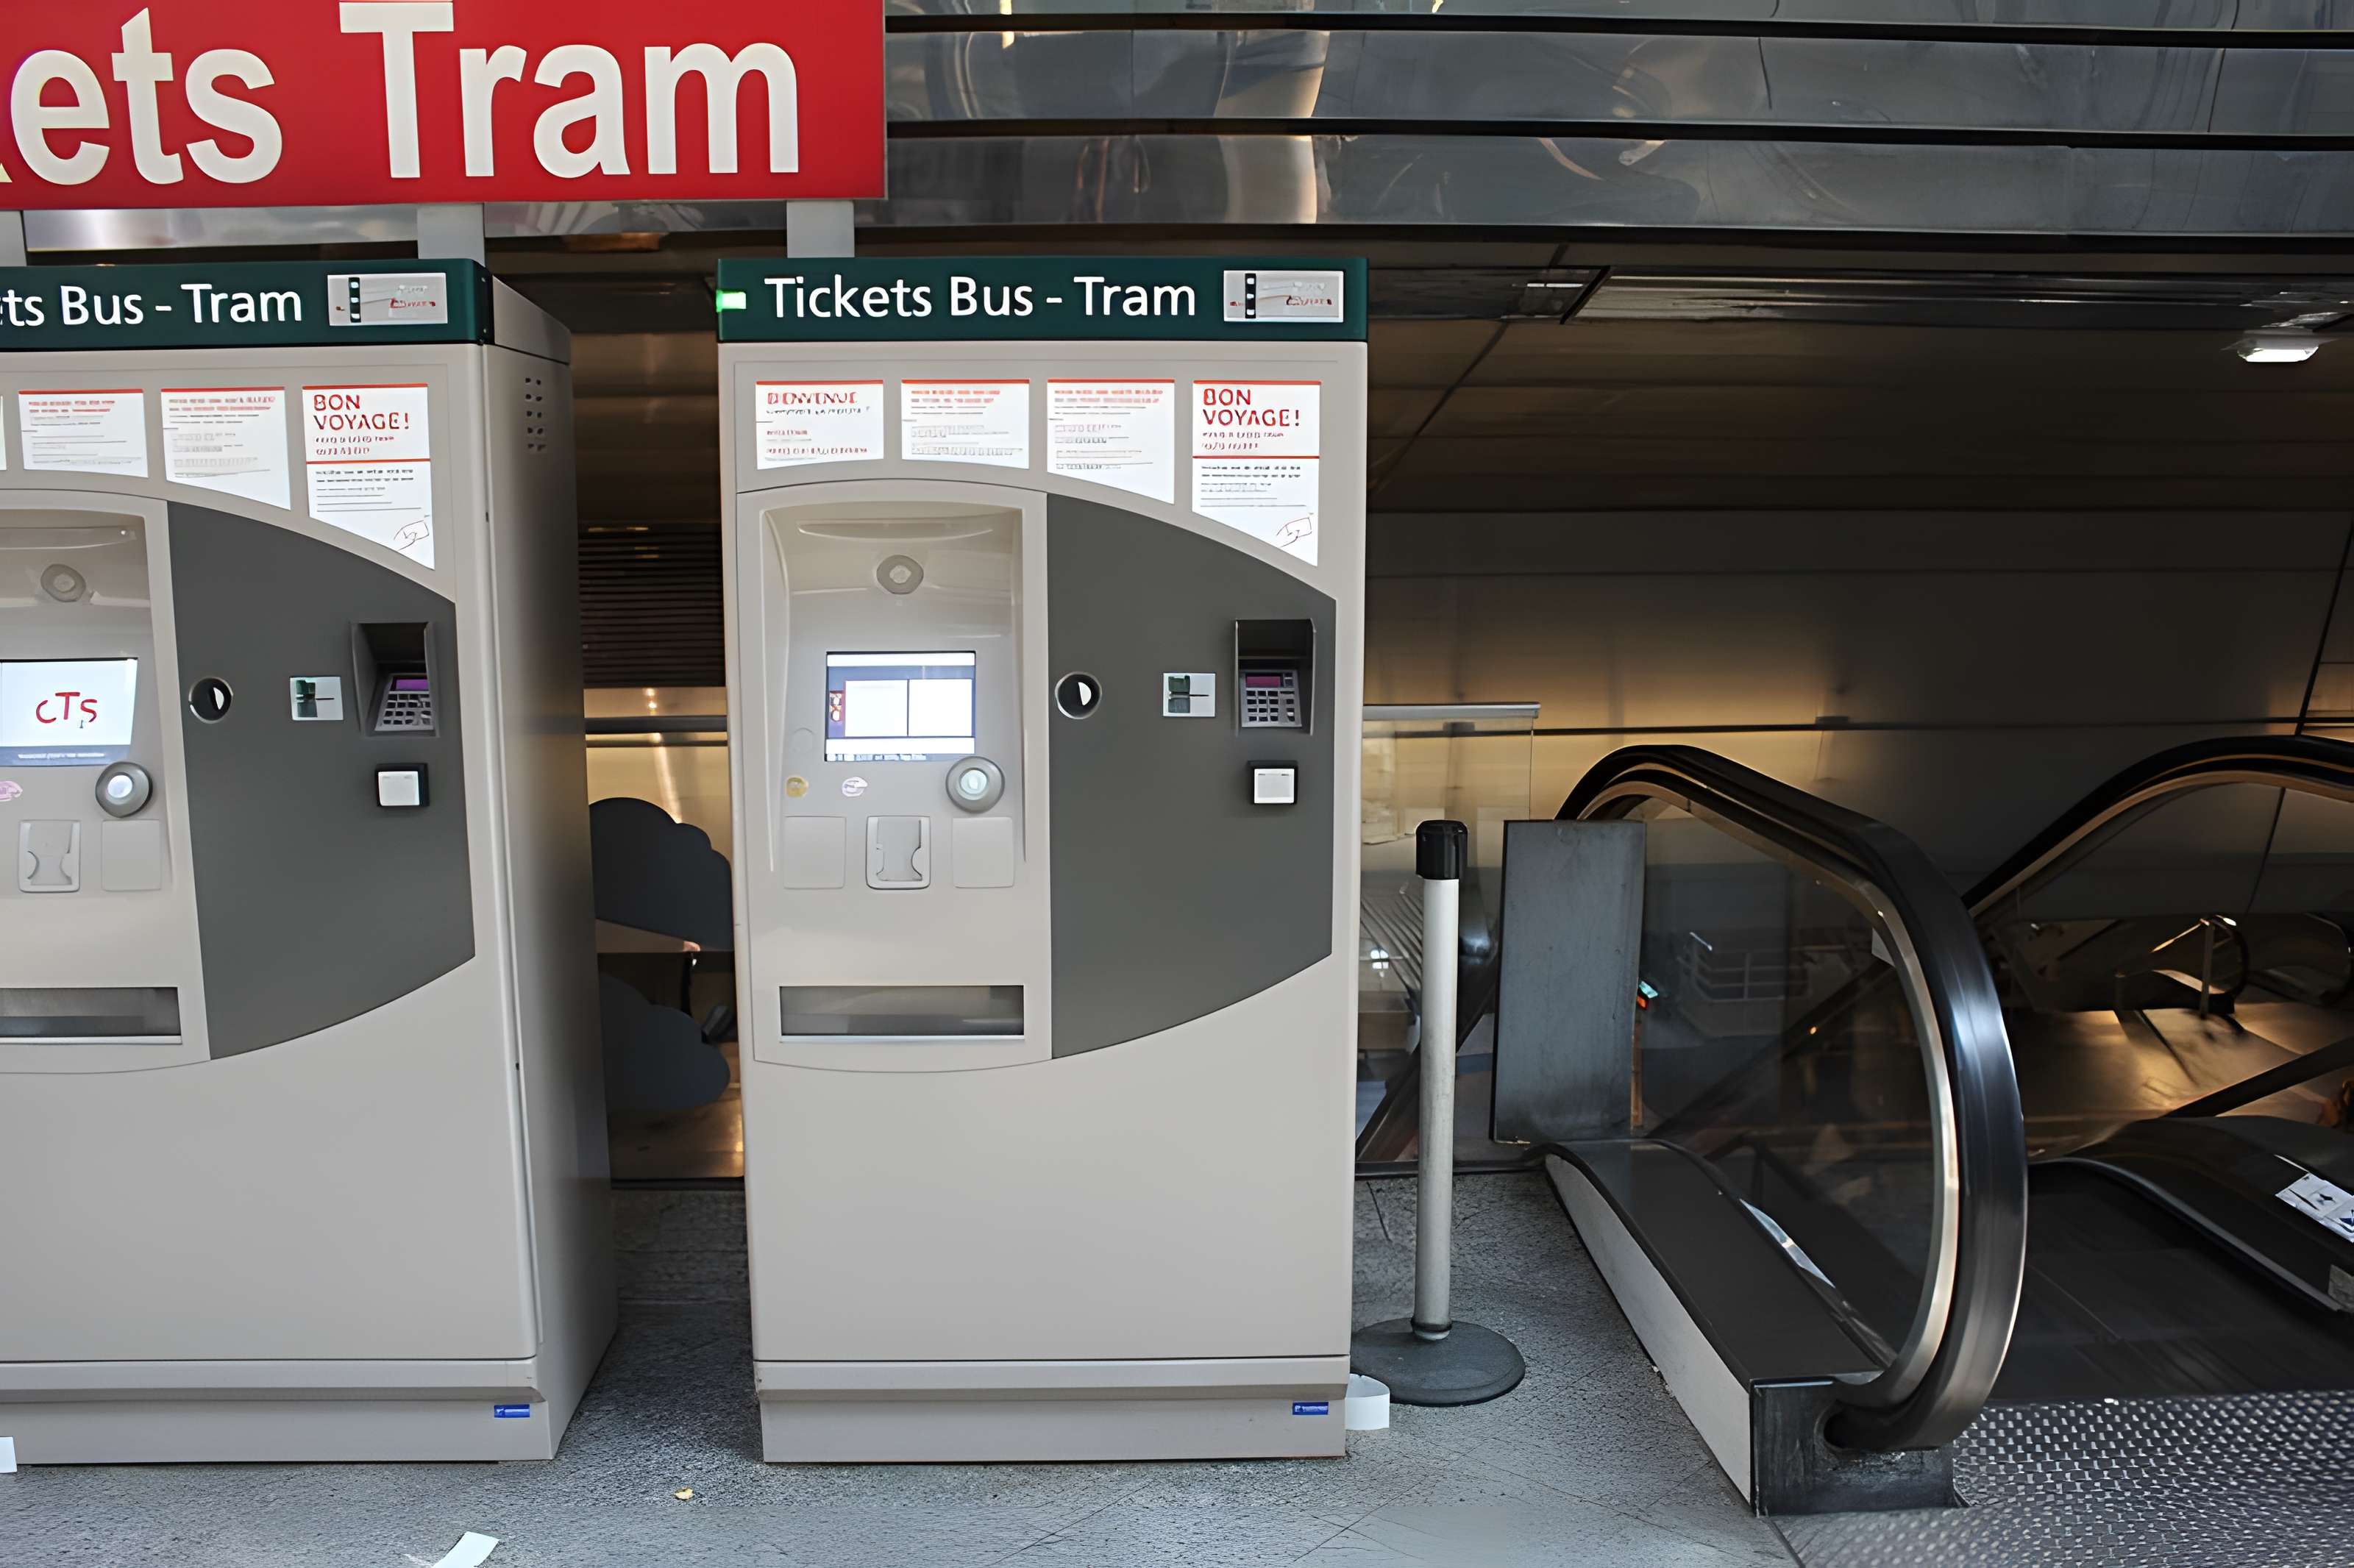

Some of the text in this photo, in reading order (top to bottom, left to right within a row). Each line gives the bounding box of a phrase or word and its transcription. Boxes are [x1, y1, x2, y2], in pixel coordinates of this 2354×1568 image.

[0, 1, 800, 185] ets Tram
[0, 289, 45, 327] ts
[60, 285, 144, 326] Bus
[180, 283, 302, 324] Tram
[764, 274, 933, 318] Tickets
[950, 276, 1034, 316] Bus
[1073, 276, 1195, 316] Tram
[313, 393, 361, 412] BON
[1203, 388, 1251, 406] BON
[313, 411, 410, 431] VOYAGE!
[1202, 408, 1300, 427] VOYAGE!
